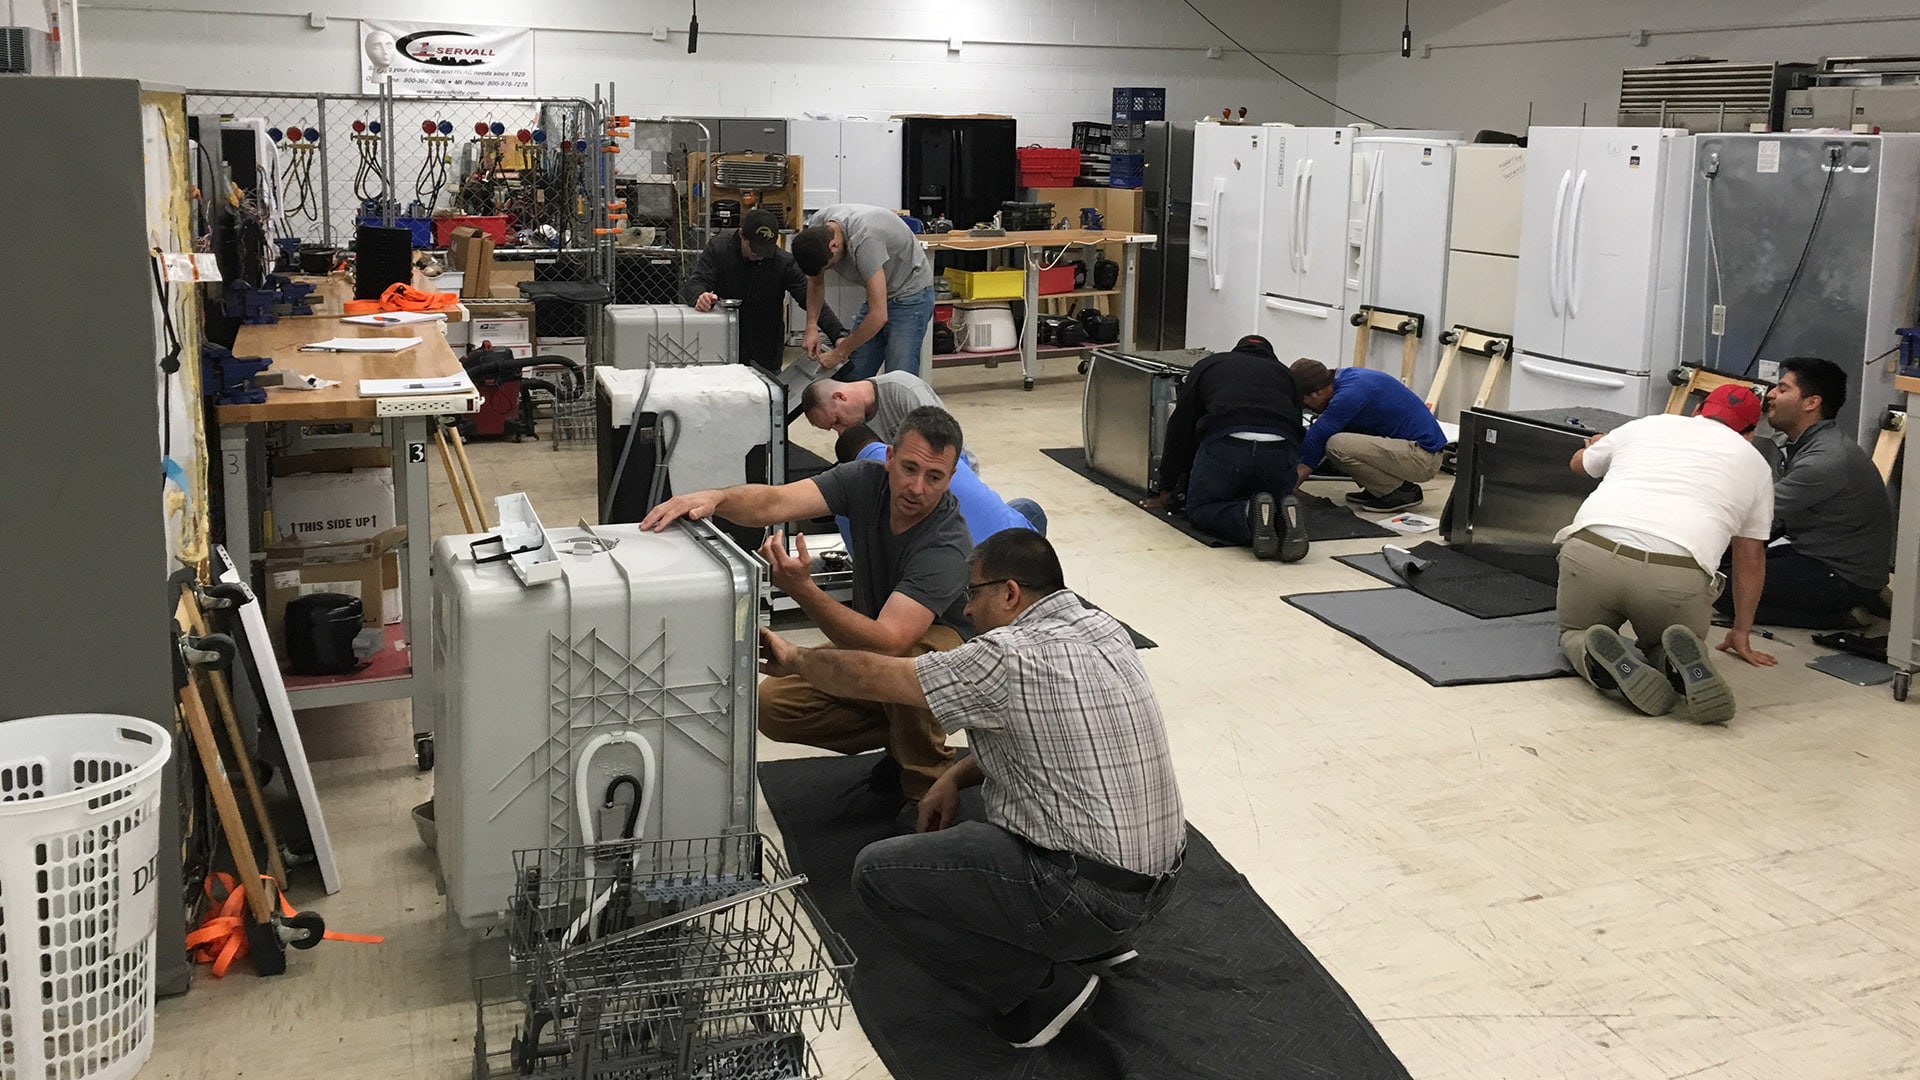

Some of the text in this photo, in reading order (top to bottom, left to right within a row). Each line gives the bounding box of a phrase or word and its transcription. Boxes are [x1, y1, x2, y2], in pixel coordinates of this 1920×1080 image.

[435, 47, 496, 57] SERVALL
[412, 443, 425, 463] 3
[227, 453, 240, 475] 3
[298, 516, 370, 532] THIS SIDE UP
